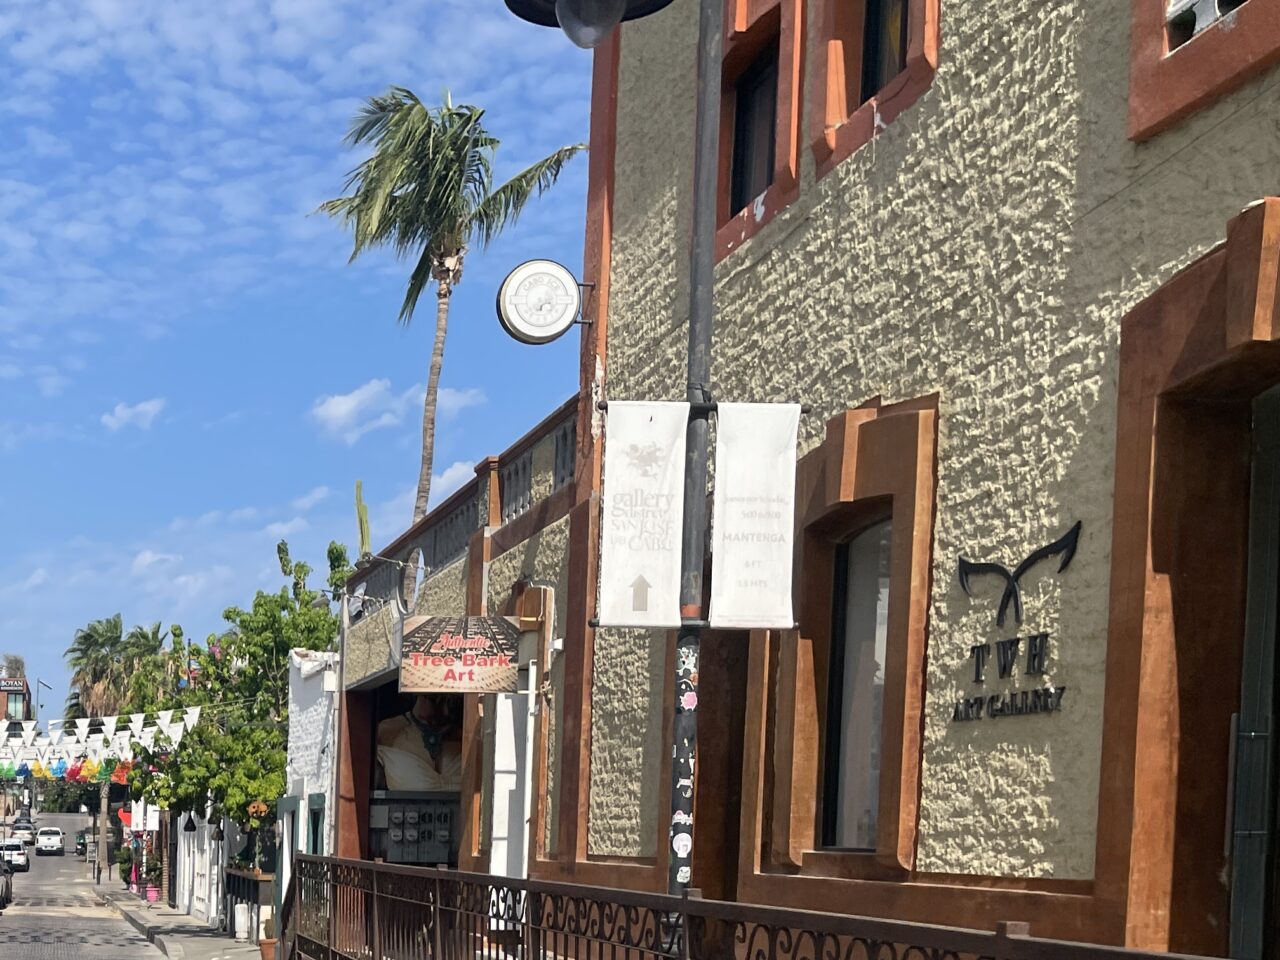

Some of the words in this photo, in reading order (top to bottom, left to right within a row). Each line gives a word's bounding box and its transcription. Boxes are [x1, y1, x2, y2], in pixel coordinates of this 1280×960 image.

[611, 488, 675, 517] gallery
[722, 532, 787, 543] MANTENGA
[411, 652, 456, 667] Tree
[463, 653, 512, 667] Bark
[443, 668, 476, 682] Art
[953, 696, 985, 722] ART
[986, 686, 1066, 719] GALLERY
